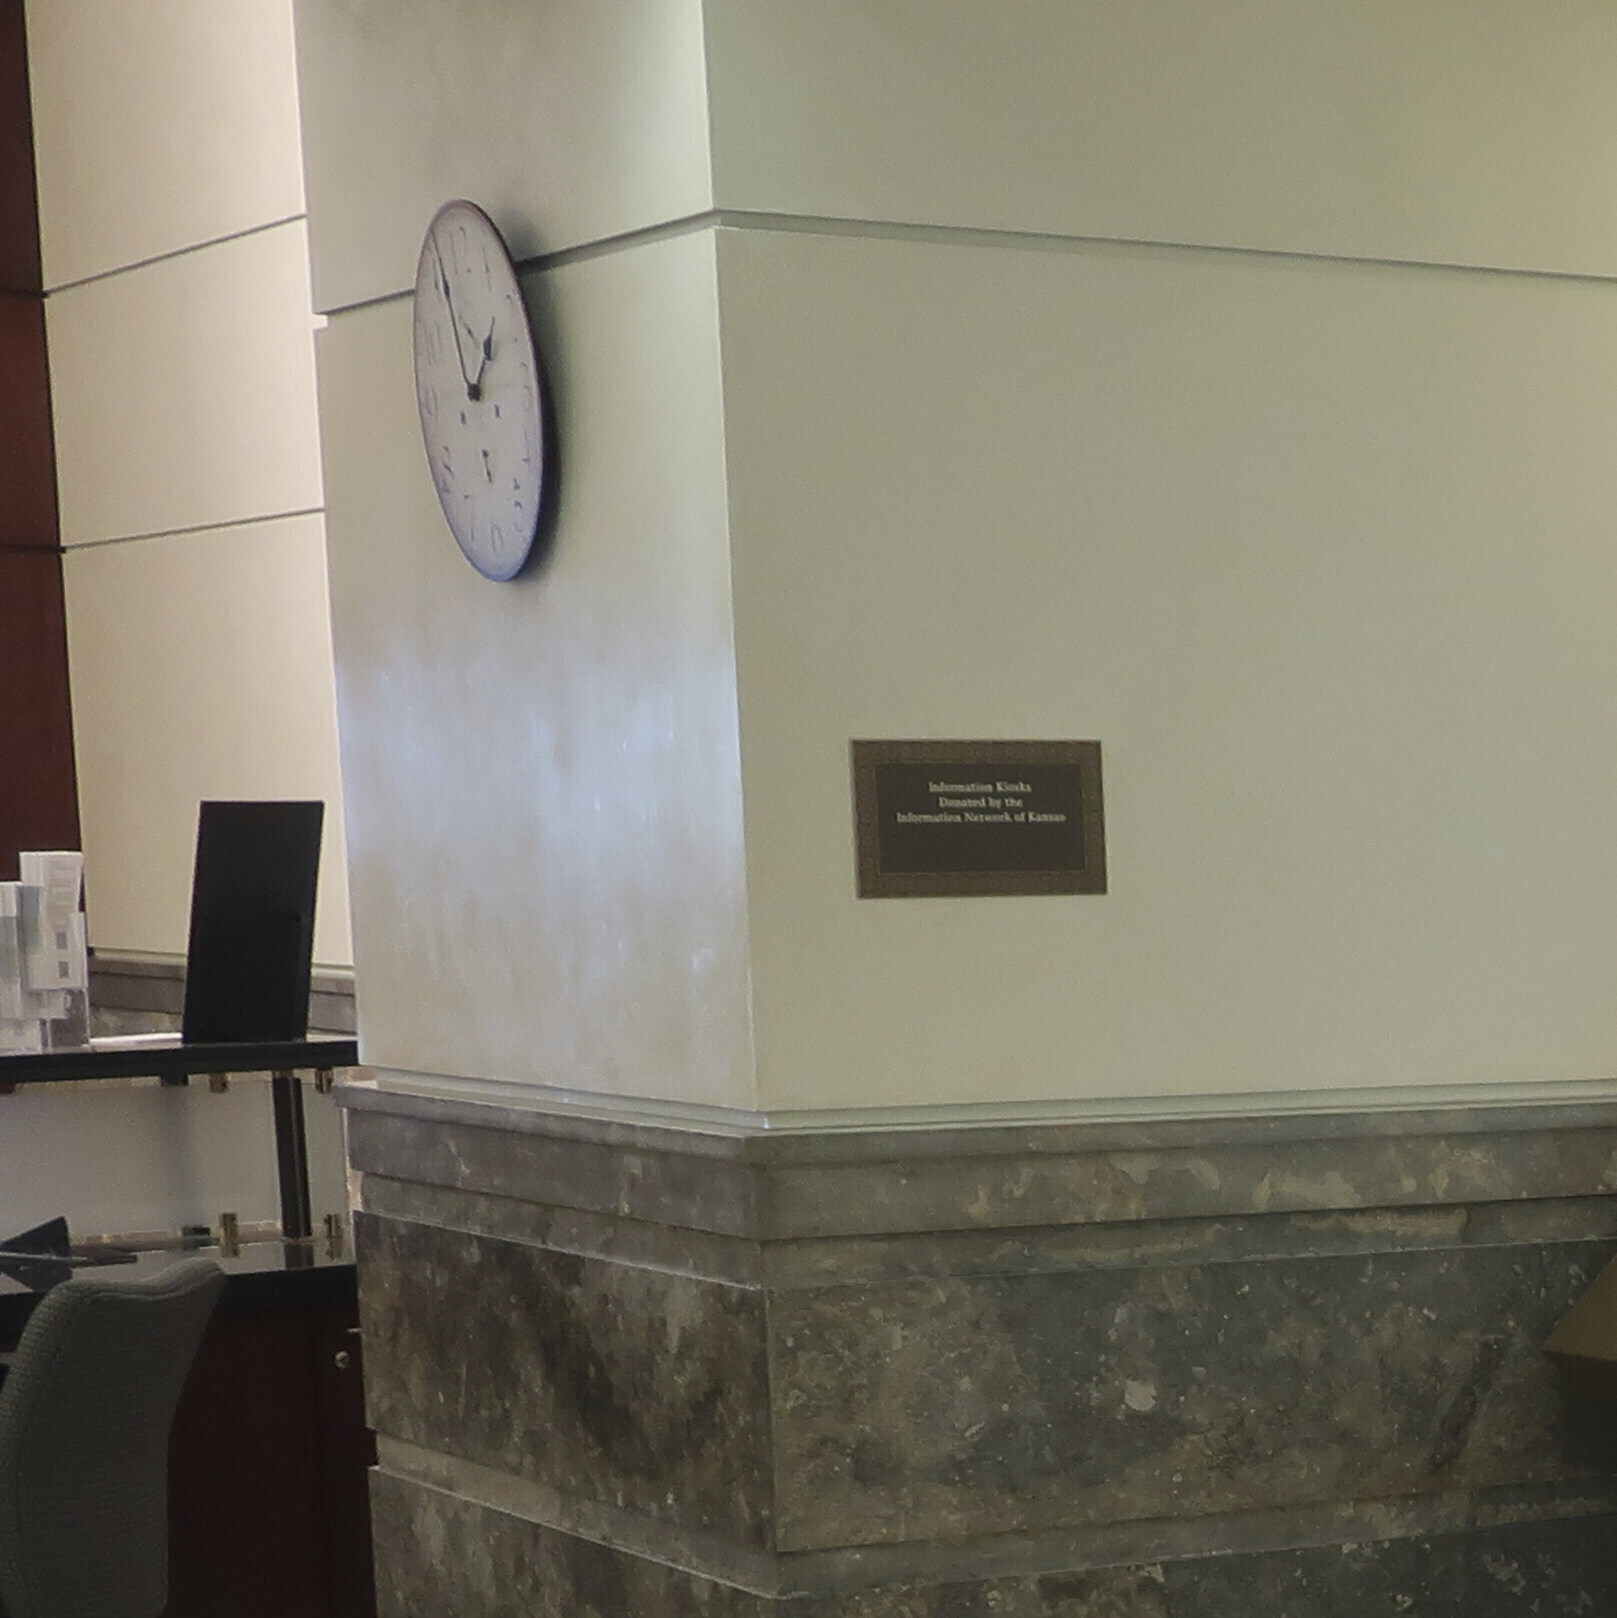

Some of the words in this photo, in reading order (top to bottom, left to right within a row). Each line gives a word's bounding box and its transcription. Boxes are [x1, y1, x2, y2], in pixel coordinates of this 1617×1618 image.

[929, 781, 993, 793] Information
[996, 781, 1032, 793] Kiosks
[939, 796, 985, 808] Donated
[988, 797, 1001, 809] by
[1004, 796, 1023, 807] the
[896, 812, 961, 824] Information
[963, 811, 1012, 822] Network
[1014, 812, 1026, 822] of
[1028, 812, 1066, 822] Kansas
